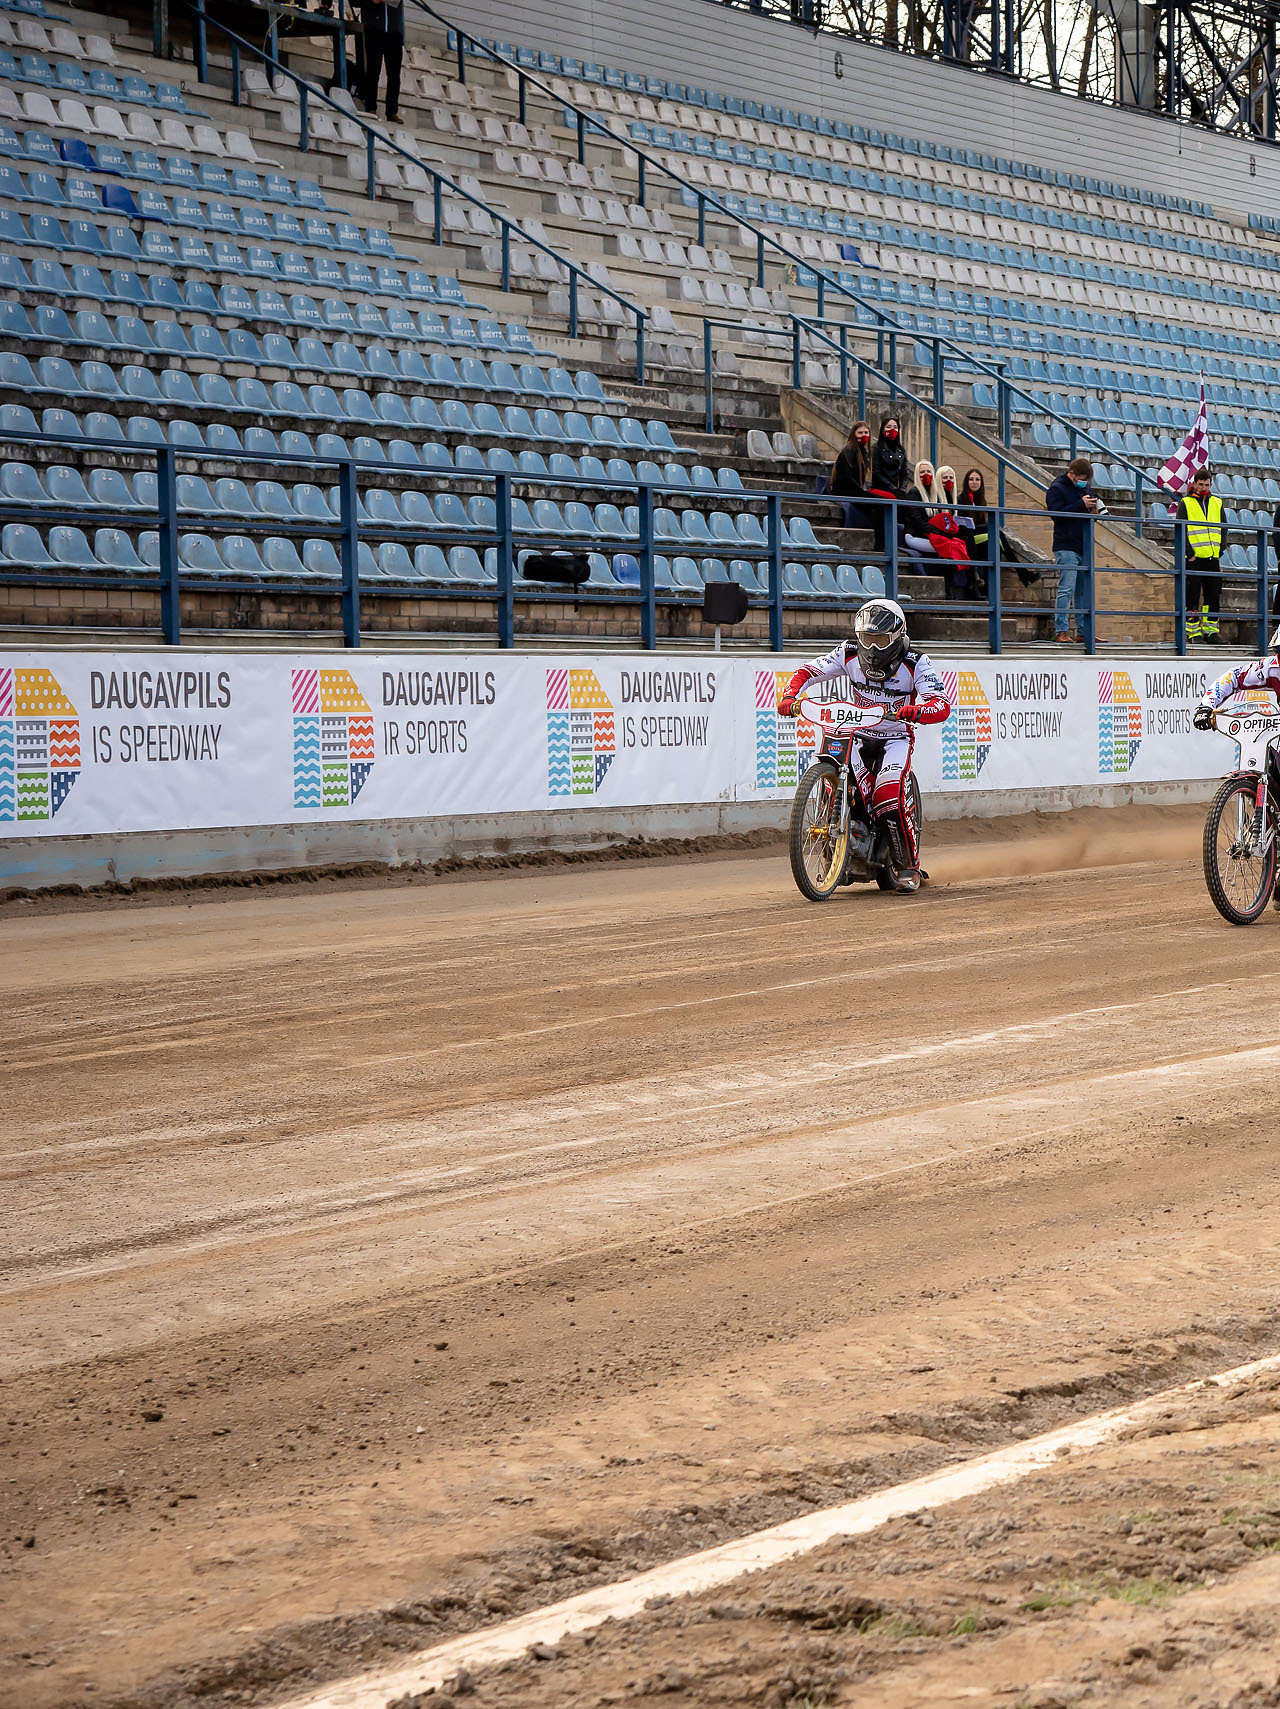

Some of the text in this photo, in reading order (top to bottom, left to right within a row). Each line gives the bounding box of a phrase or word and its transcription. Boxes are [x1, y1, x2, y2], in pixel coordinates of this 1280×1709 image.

[91, 671, 231, 709] DAUGAVPILS
[382, 670, 496, 706] DAUGAVPILS
[620, 671, 716, 703] DAUGAVPILS
[996, 673, 1068, 700] DAUGAVPILS
[1145, 672, 1207, 698] DAUGAVPILS
[622, 715, 709, 748] IS SPEEDWAY
[820, 709, 863, 723] HL BAU
[996, 711, 1063, 739] IS SPEEDWAY
[1146, 708, 1191, 735] IR SPORTS
[93, 724, 221, 763] IS SPEEDWAY
[383, 720, 467, 755] IR SPORTS
